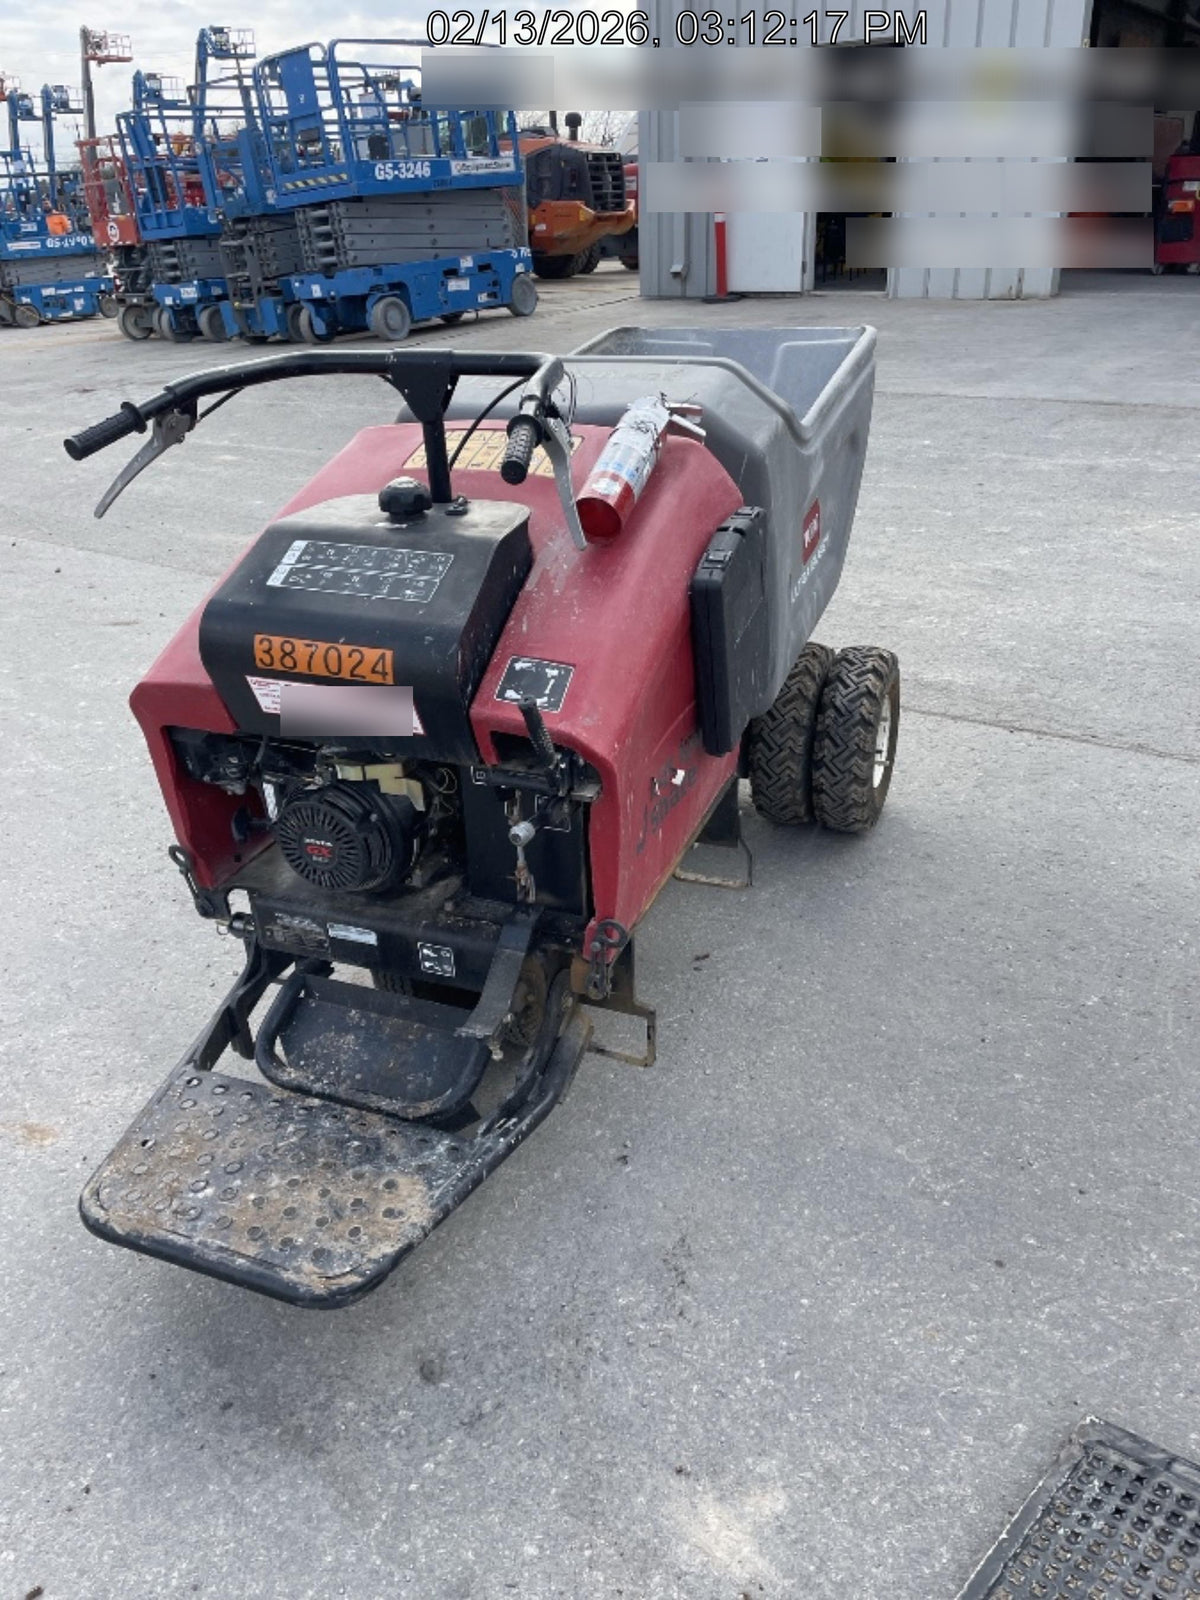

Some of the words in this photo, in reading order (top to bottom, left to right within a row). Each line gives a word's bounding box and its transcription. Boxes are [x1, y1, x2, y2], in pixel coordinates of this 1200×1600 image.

[374, 162, 431, 181] GS-3246
[258, 637, 389, 682] 387024
[306, 845, 332, 858] GX
